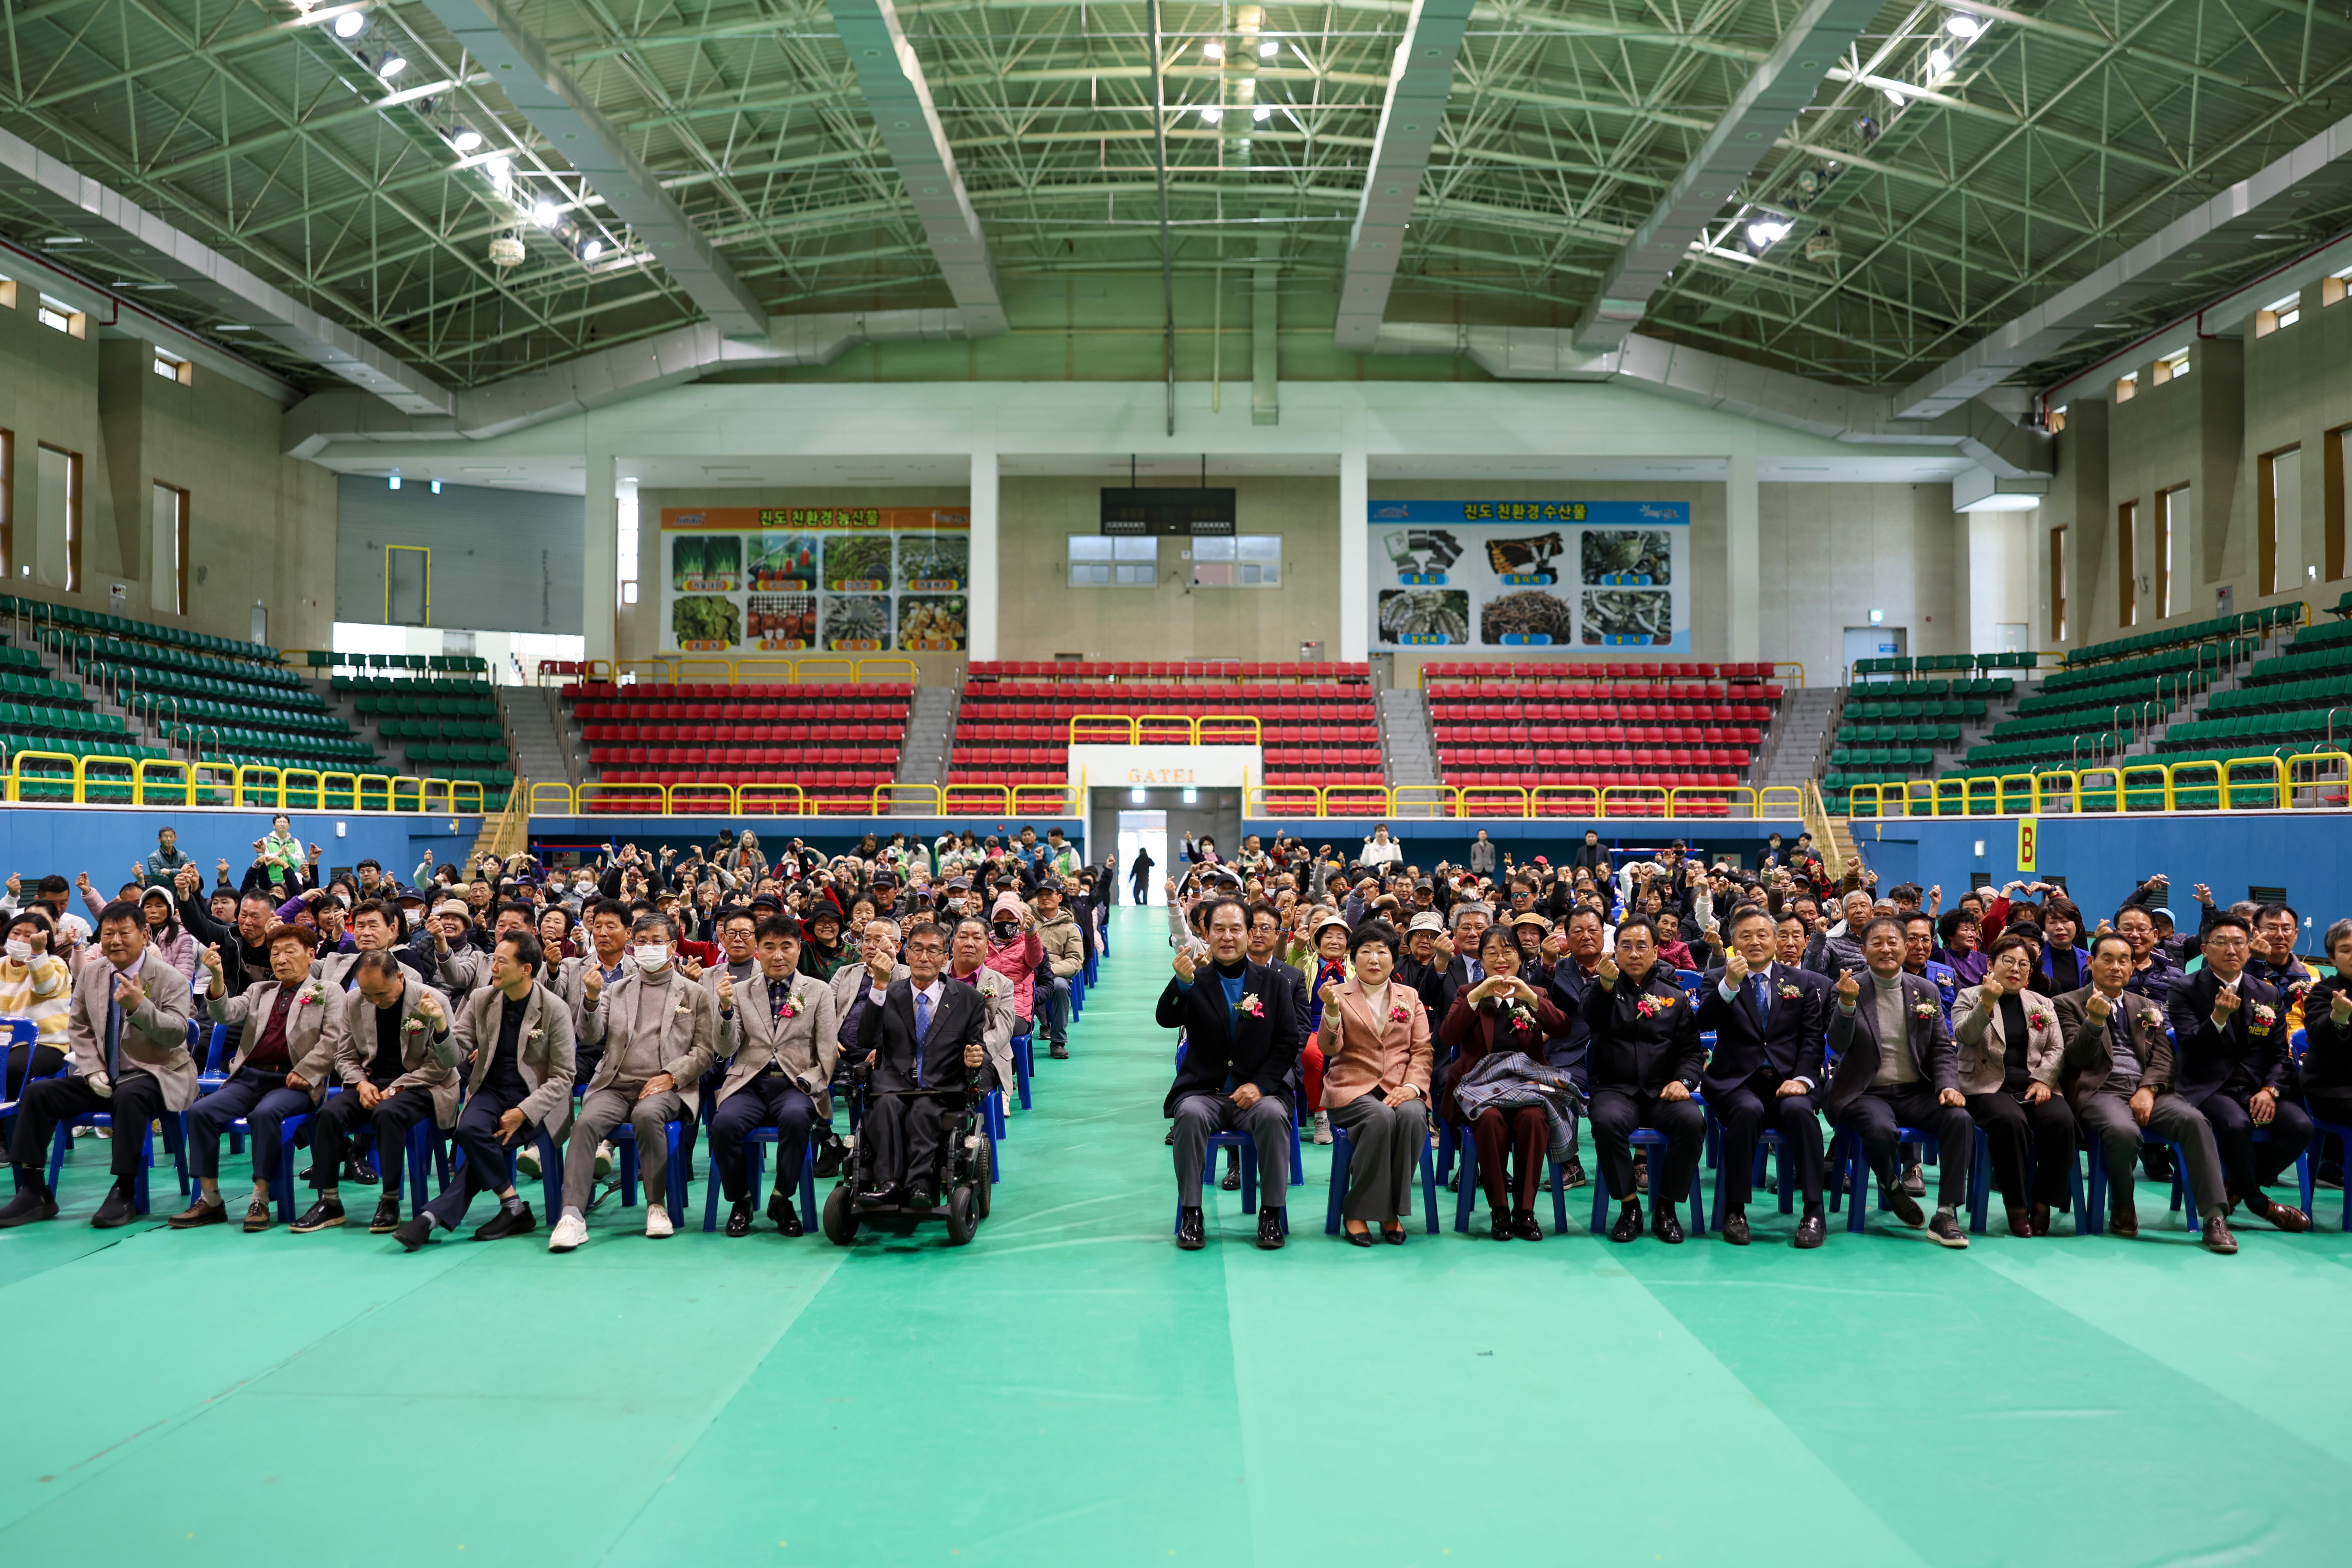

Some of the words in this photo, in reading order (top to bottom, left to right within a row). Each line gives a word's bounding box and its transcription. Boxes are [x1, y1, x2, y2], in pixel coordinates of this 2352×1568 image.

[760, 509, 788, 527] 진도
[791, 509, 833, 527] 친환경
[837, 509, 880, 527] 농산물
[1464, 503, 1493, 520] 진도
[1497, 503, 1540, 520] 친환경
[1543, 503, 1587, 520] 수산물
[2022, 827, 2033, 863] B
